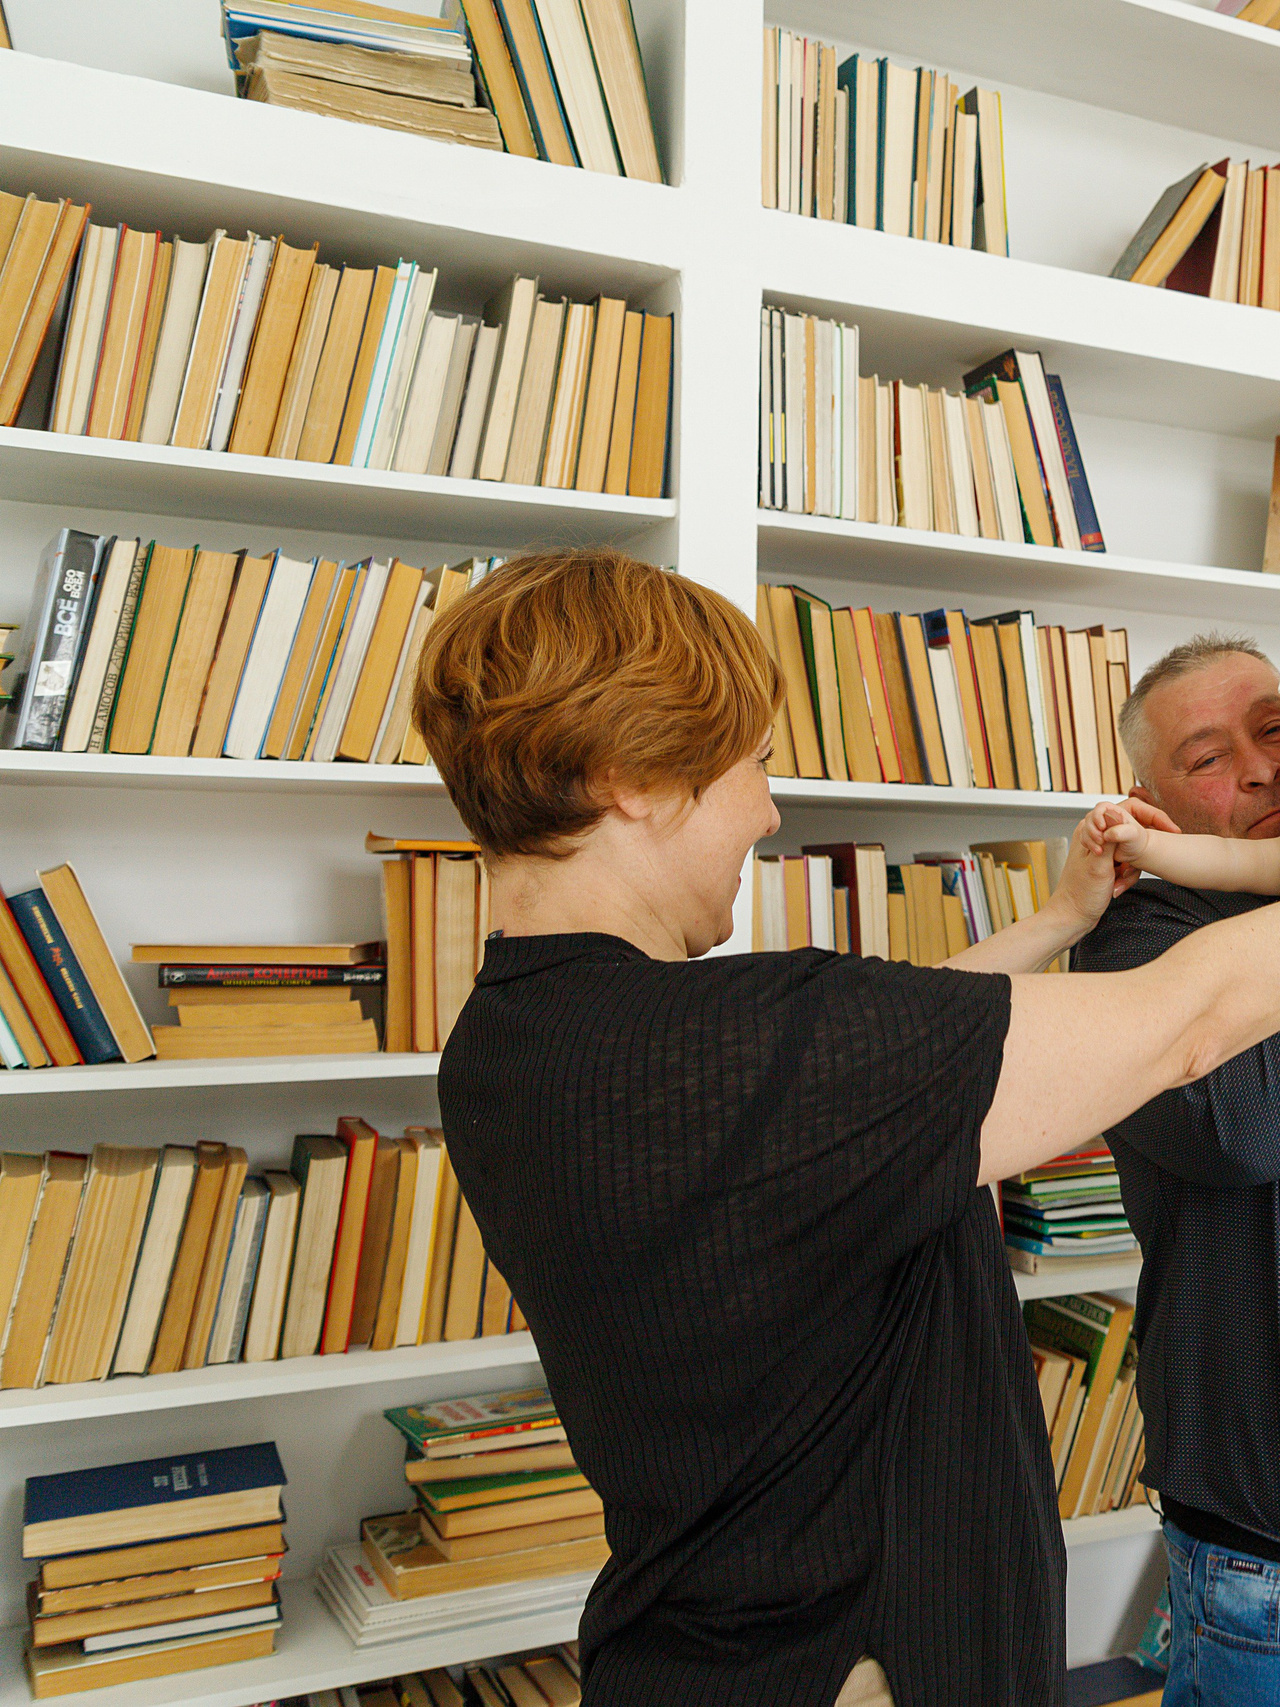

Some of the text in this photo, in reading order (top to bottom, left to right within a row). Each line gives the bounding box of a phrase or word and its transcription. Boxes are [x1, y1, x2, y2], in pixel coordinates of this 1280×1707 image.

[62, 569, 76, 592] ОБО
[97, 672, 118, 722] АМОСОВ
[253, 967, 328, 979] КОЧЕРГИН
